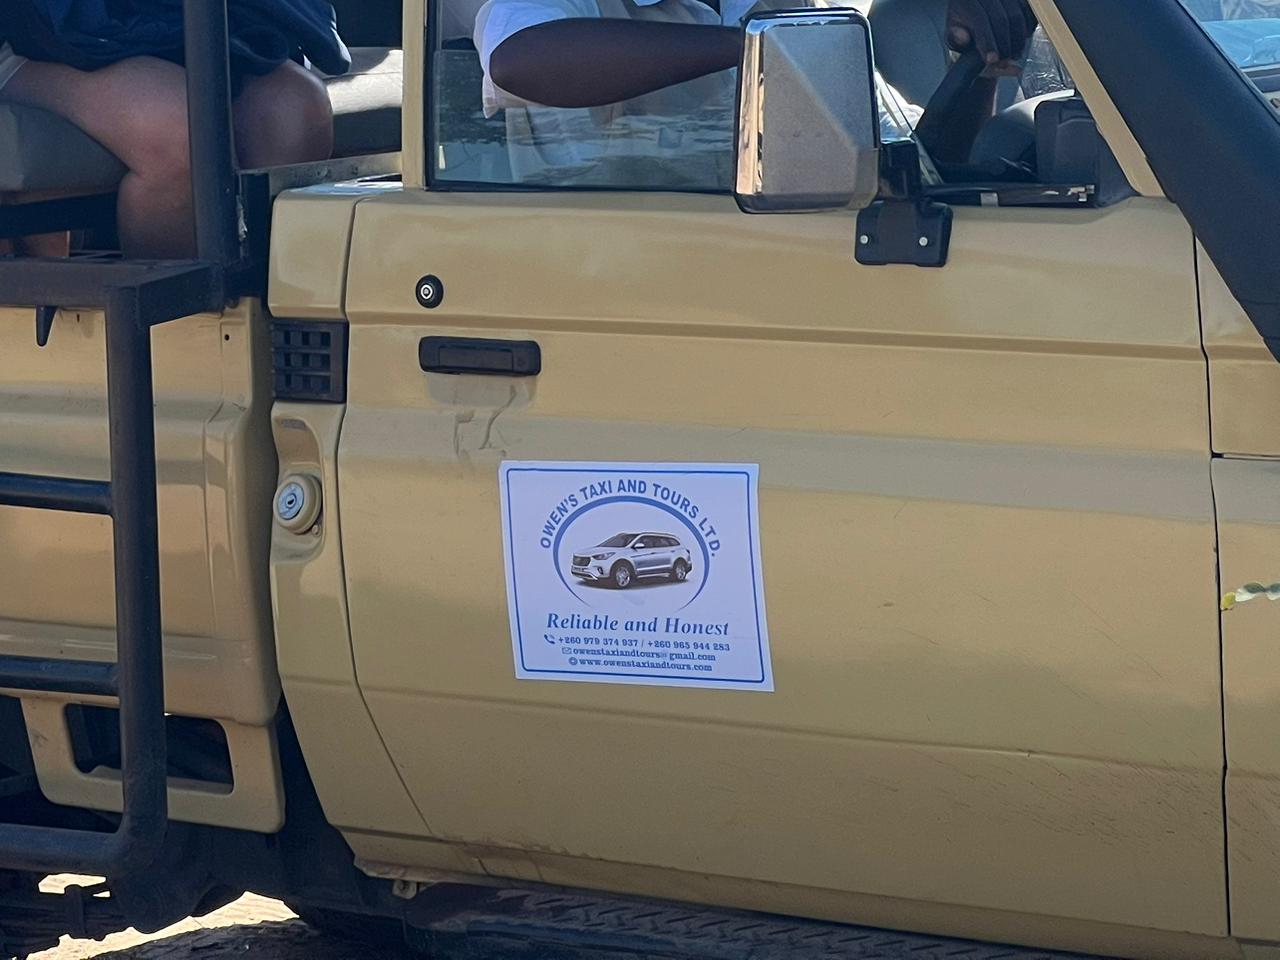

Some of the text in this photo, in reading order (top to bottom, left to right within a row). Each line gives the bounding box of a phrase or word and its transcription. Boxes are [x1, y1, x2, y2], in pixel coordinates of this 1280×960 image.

[540, 479, 721, 557] OWEN'S TAXI AND TOURS LTD.
[546, 613, 729, 636] Reliable and Honest
[558, 636, 581, 644] +260
[603, 638, 619, 646] 374
[622, 639, 638, 647] 937
[648, 640, 671, 649] +260
[693, 641, 710, 650] 944
[579, 658, 713, 672] www.owenstaxiandtours.com
